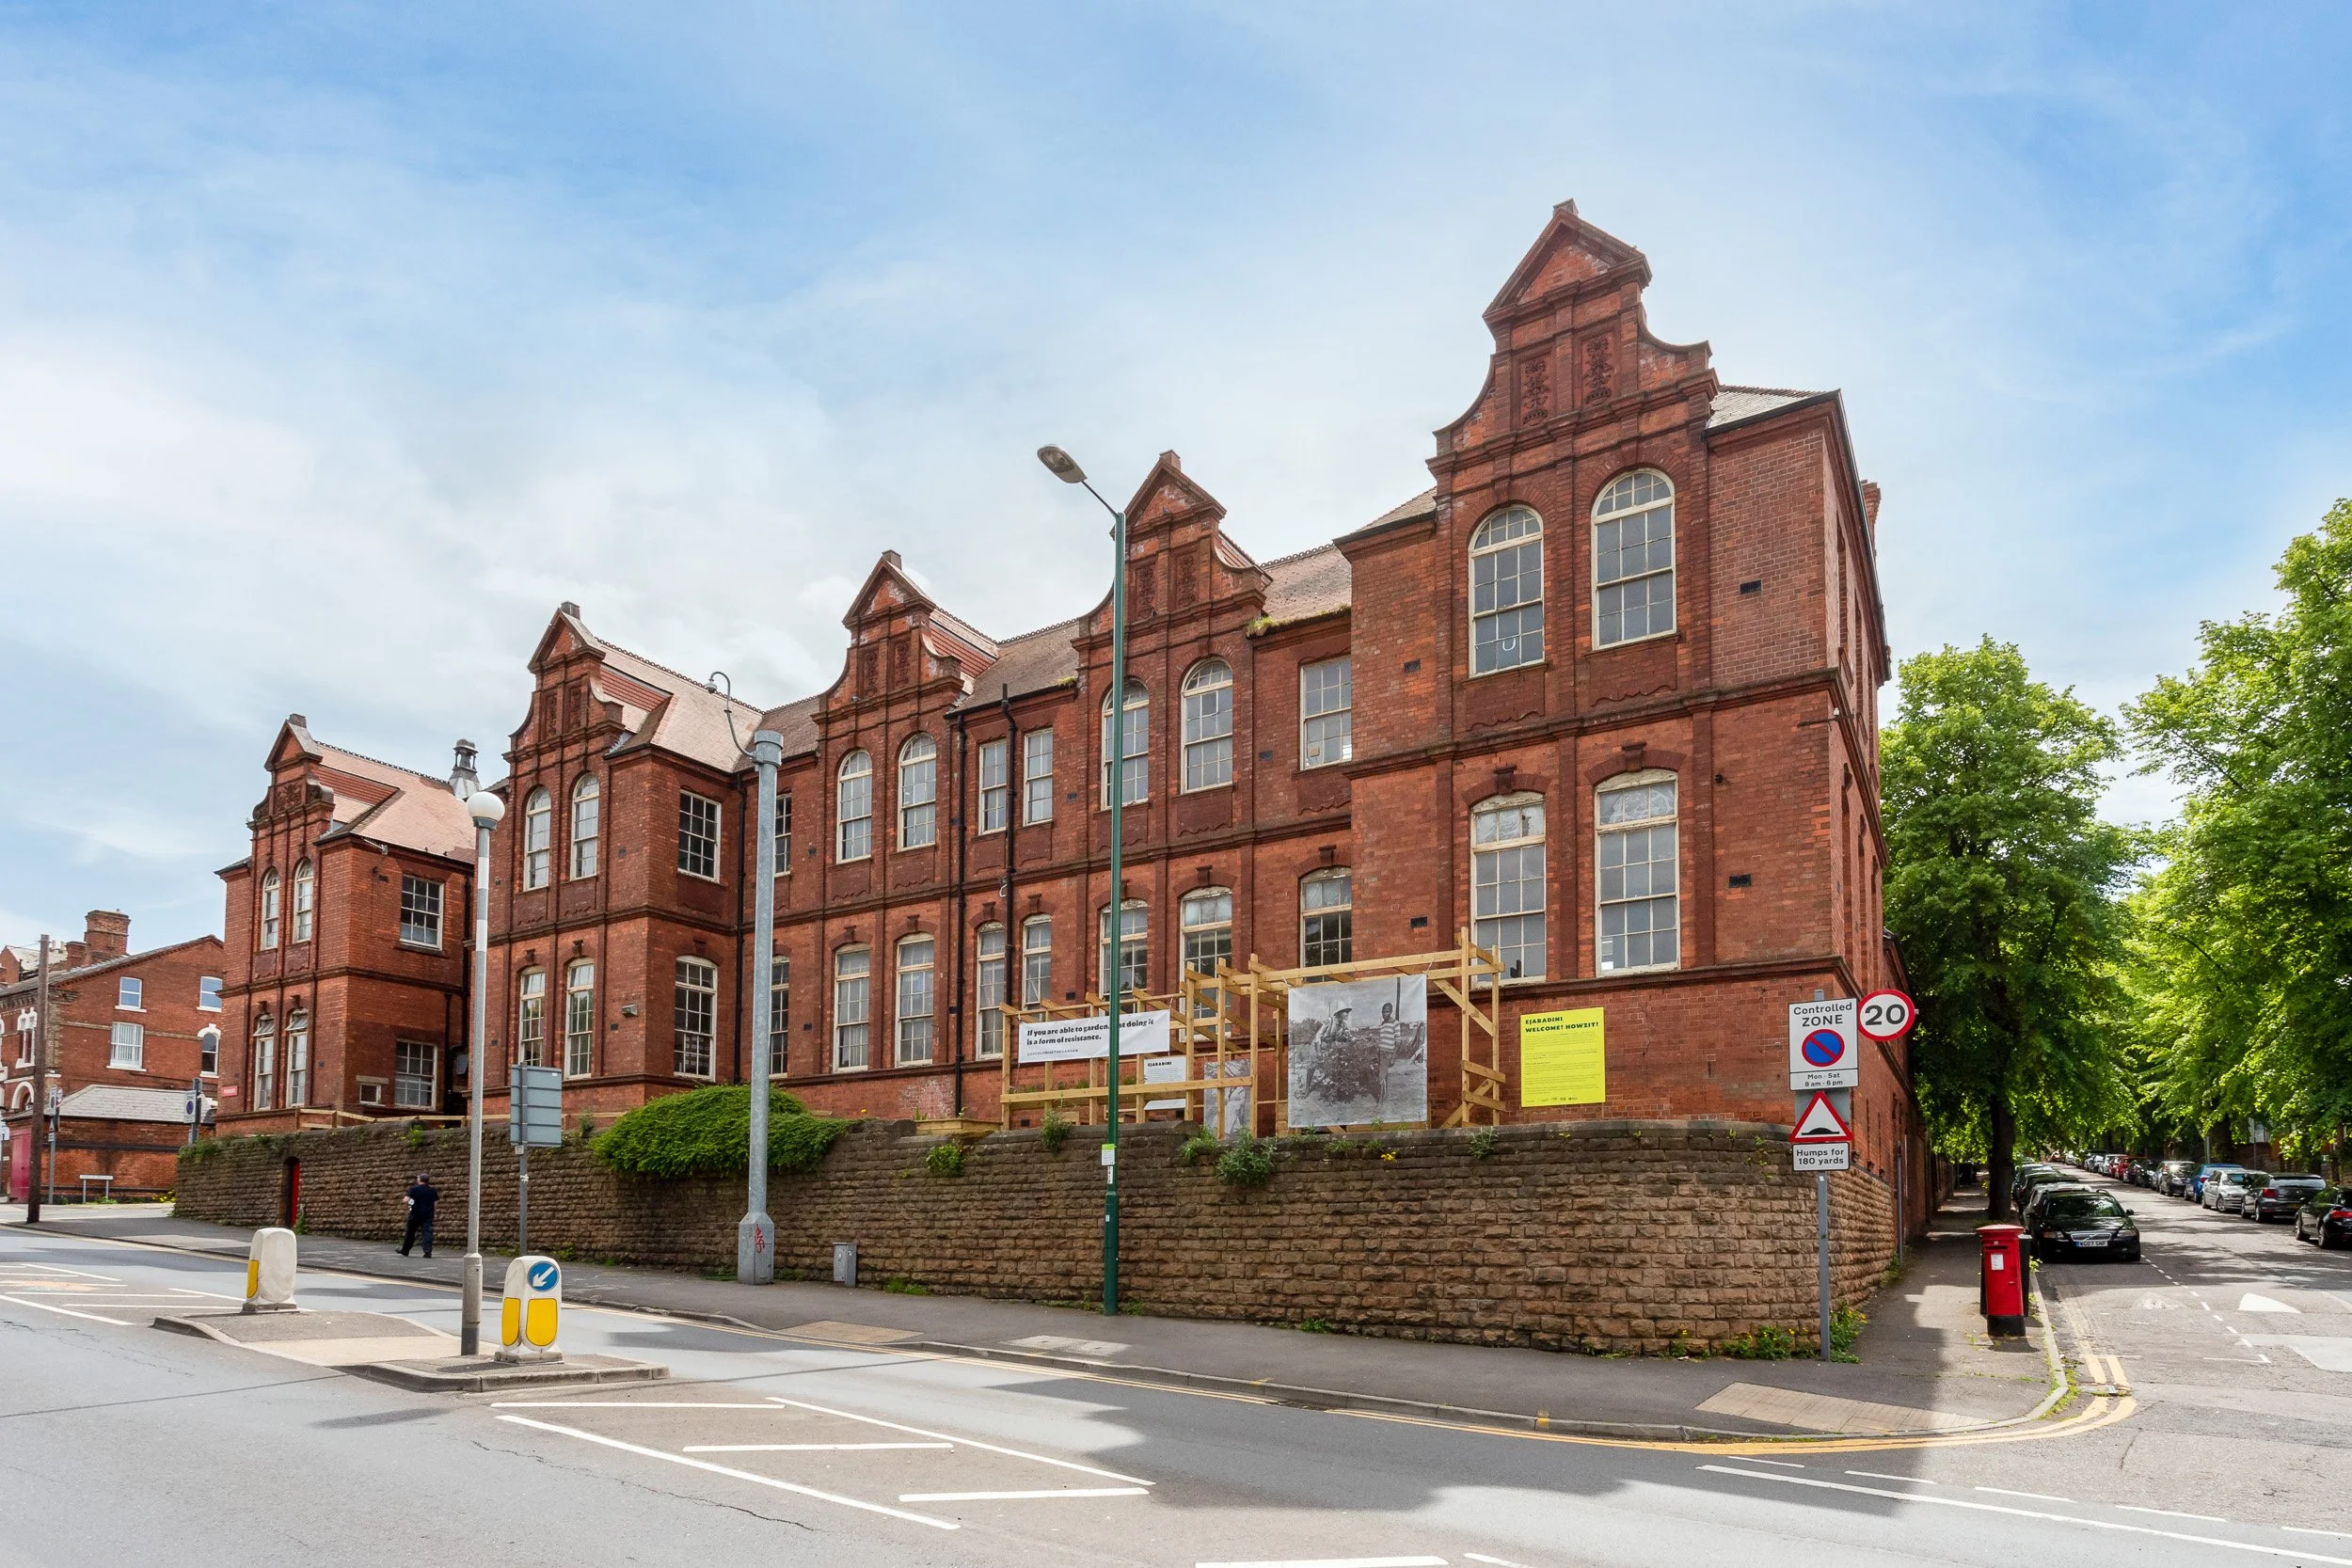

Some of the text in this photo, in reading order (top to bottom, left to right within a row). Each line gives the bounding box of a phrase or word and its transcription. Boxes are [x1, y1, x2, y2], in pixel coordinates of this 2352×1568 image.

[1793, 1003, 1852, 1016] Controlled
[1865, 1004, 1906, 1026] 20
[1126, 1020, 1147, 1028] doing
[1525, 1016, 1564, 1024] EJARADINI
[1802, 1014, 1843, 1027] ZONE
[1525, 1022, 1598, 1033] WELCOME! HOWZIT!
[1064, 1034, 1102, 1043] resistance.
[1796, 1149, 1828, 1158] Humps
[1818, 1156, 1844, 1165] yards
